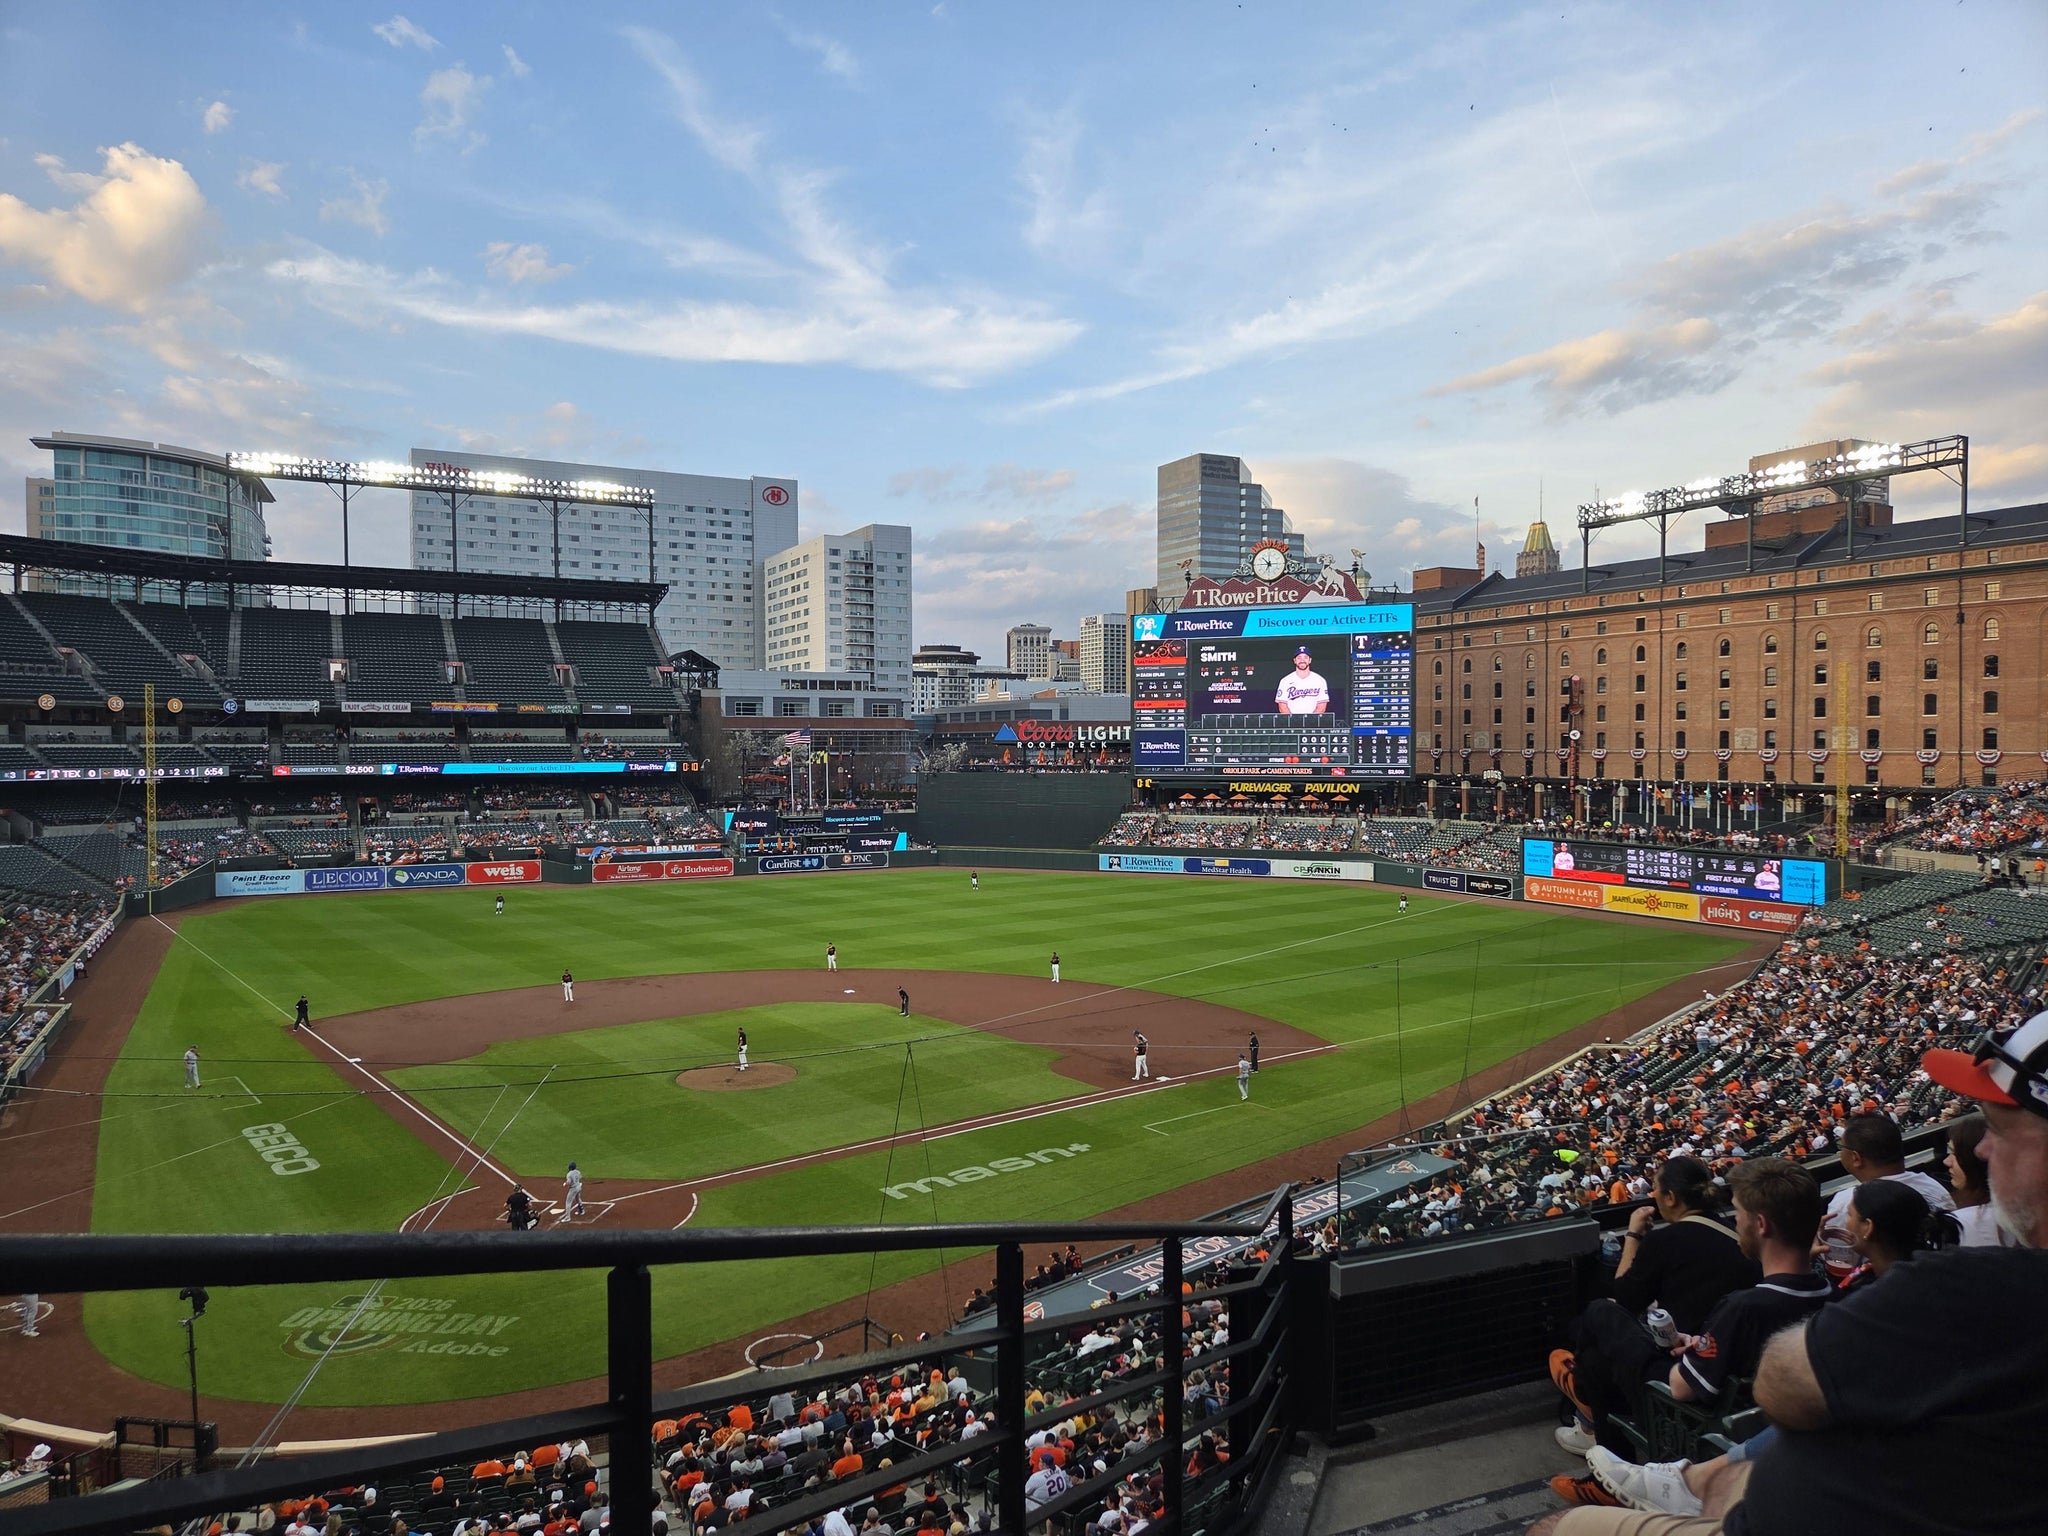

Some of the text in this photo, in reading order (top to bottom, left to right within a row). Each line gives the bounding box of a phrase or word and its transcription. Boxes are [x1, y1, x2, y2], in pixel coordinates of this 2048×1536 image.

[1258, 617, 1306, 628] Discover
[1308, 618, 1329, 626] our
[1331, 615, 1366, 625] Active
[1369, 613, 1398, 624] ETFs
[1200, 651, 1237, 662] SMITH
[1287, 686, 1321, 700] Rangers
[41, 698, 53, 706] 22
[225, 702, 236, 710] 42
[1018, 719, 1132, 741] Coors LIGHT
[62, 770, 81, 778] TEX
[114, 769, 131, 777] BAL
[173, 768, 180, 776] 2
[204, 767, 223, 776] 6:54
[345, 766, 374, 774] $2,500
[1229, 783, 1360, 793] PUREWAGER PAVILION
[646, 844, 695, 853] BIRD BATH
[765, 859, 802, 869] CareFirst
[852, 855, 872, 863] PNC
[483, 864, 525, 877] weis
[617, 864, 642, 873] Airtemp
[684, 865, 729, 874] Budweiser
[1769, 860, 1781, 873] T
[409, 870, 459, 880] VANDA
[1428, 875, 1449, 884] TRUIST
[1705, 874, 1746, 884] FIRST AT-BAT
[1541, 884, 1599, 899] AUTUMN LAKE
[1701, 885, 1719, 893] JOSH
[1719, 887, 1739, 895] SMITH
[1612, 895, 1689, 910] MARYLAND LOTTERY
[1707, 906, 1741, 922] HIGH'S
[1762, 911, 1797, 922] CARROLL
[241, 1122, 321, 1176] GEICO
[279, 1306, 521, 1337] OPENING DAY
[400, 1339, 510, 1357] Adobe
[1046, 1476, 1066, 1497] 20
